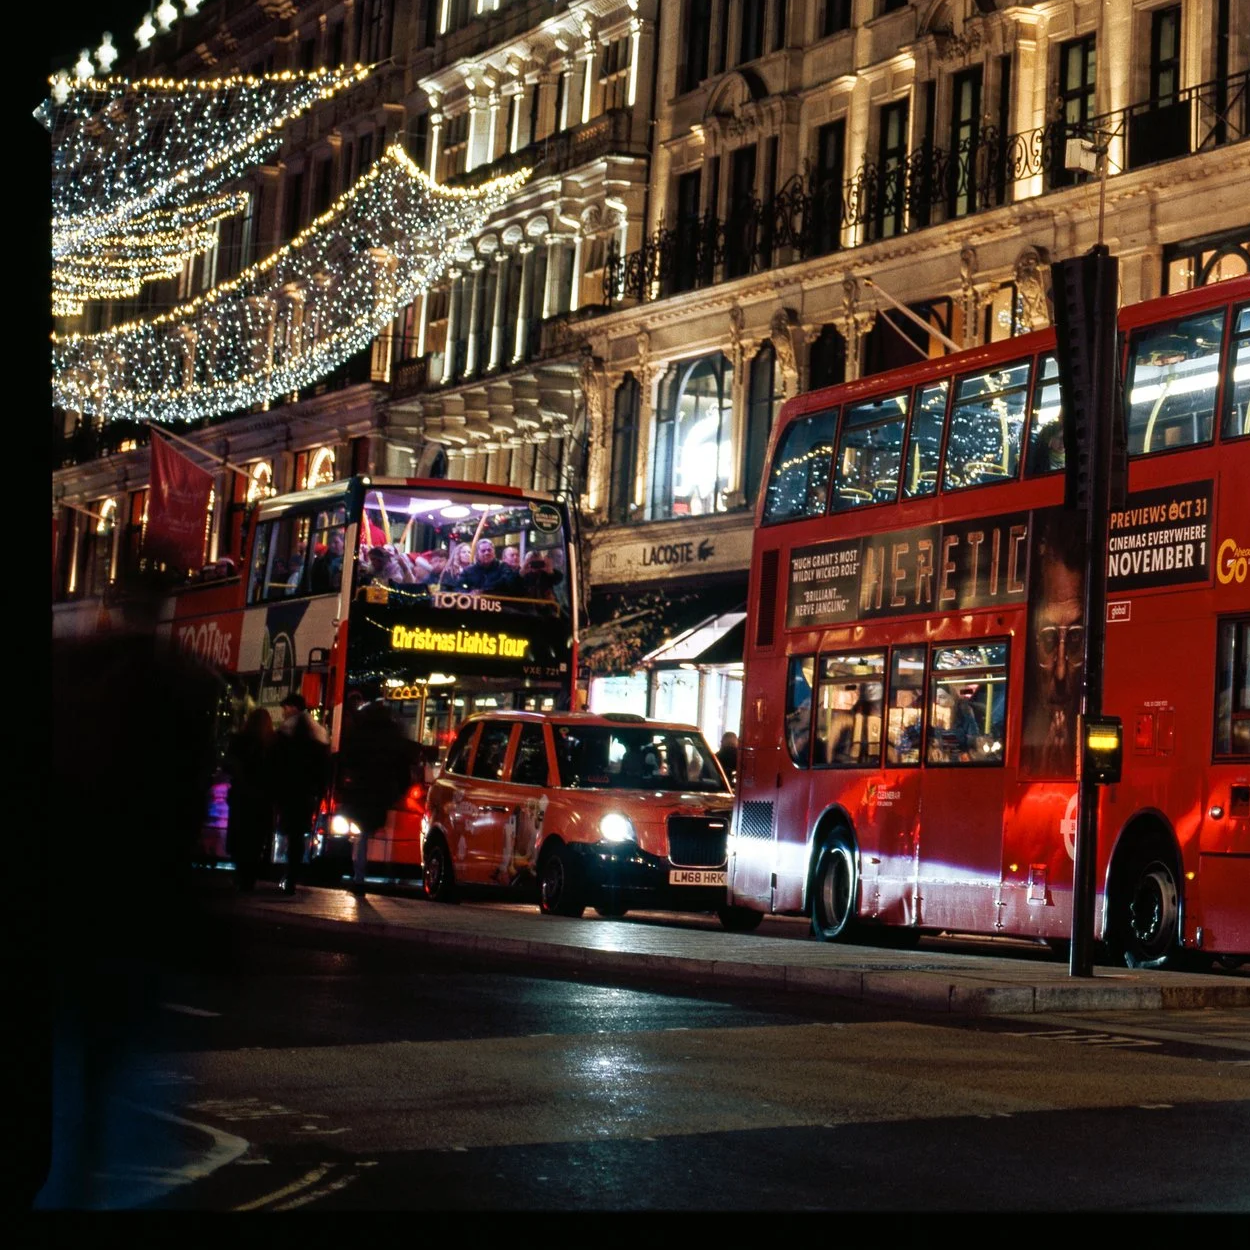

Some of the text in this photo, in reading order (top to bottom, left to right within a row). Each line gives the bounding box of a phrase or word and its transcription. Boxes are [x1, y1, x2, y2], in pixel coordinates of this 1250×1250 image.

[1110, 498, 1207, 530] PREVIEWS OCT 31
[1109, 525, 1207, 551] CINEMAS EVERYWHERE
[643, 542, 694, 566] LACOSTE
[840, 550, 857, 563] MOST
[1108, 542, 1206, 578] NOVEMBER 1
[1217, 538, 1248, 585] Go
[793, 570, 815, 583] WILDLY
[816, 566, 840, 579] WICKED
[863, 525, 1027, 611] HERETIC
[434, 592, 502, 612] TOOTBUS
[795, 604, 815, 617] NERVE
[178, 621, 233, 666] TOOTBUS
[392, 625, 529, 657] Christmas Lights Tour
[674, 871, 725, 883] LM68 HRK
